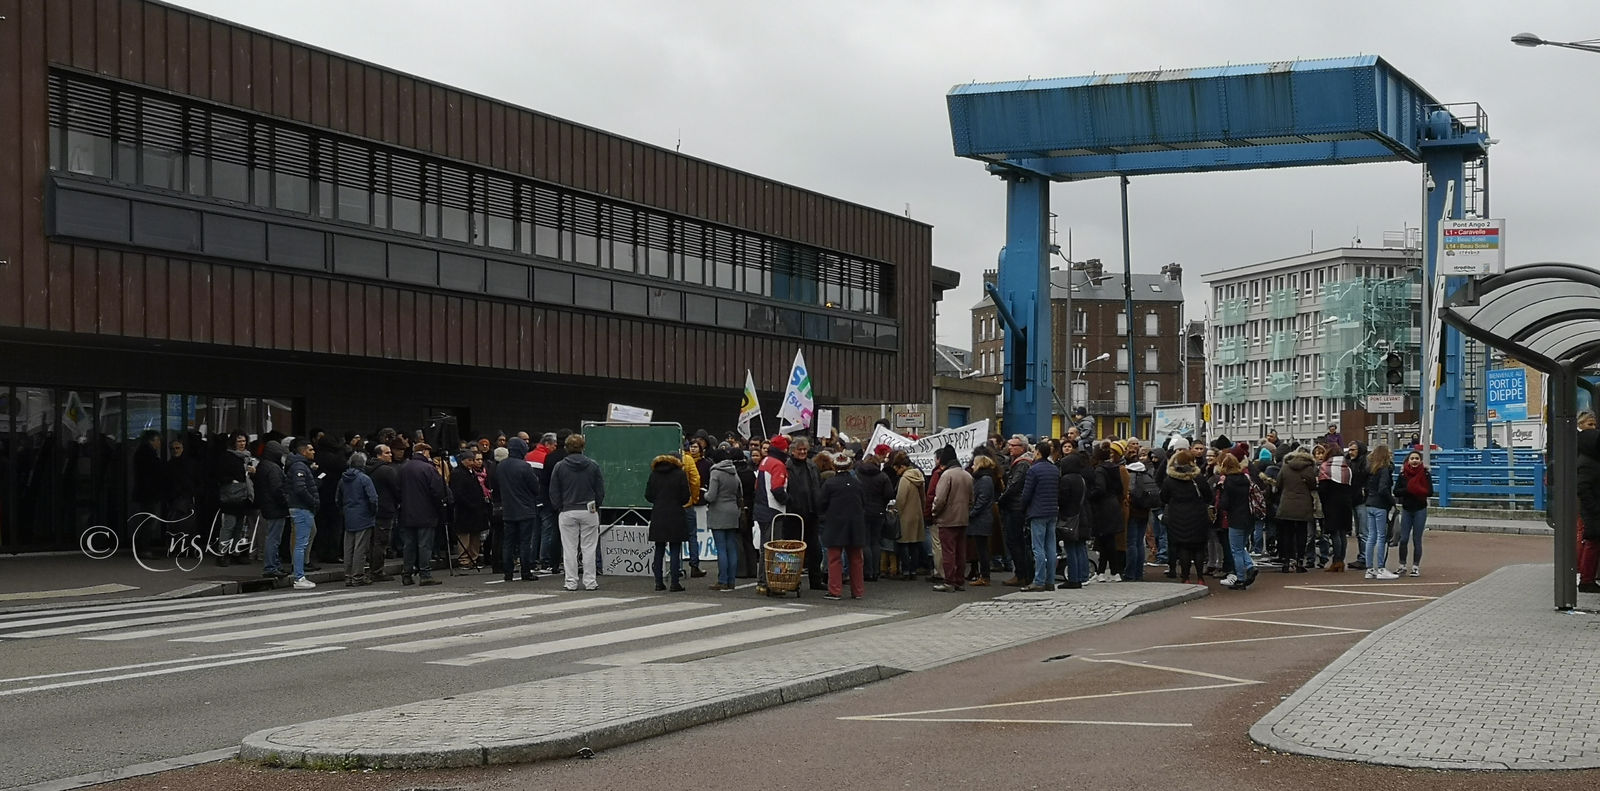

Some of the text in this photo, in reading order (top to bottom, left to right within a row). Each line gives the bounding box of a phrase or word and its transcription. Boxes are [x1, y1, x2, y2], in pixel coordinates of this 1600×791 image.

[1490, 378, 1523, 389] PORT DE
[1490, 388, 1523, 401] DIEPPE
[624, 558, 651, 574] 201
